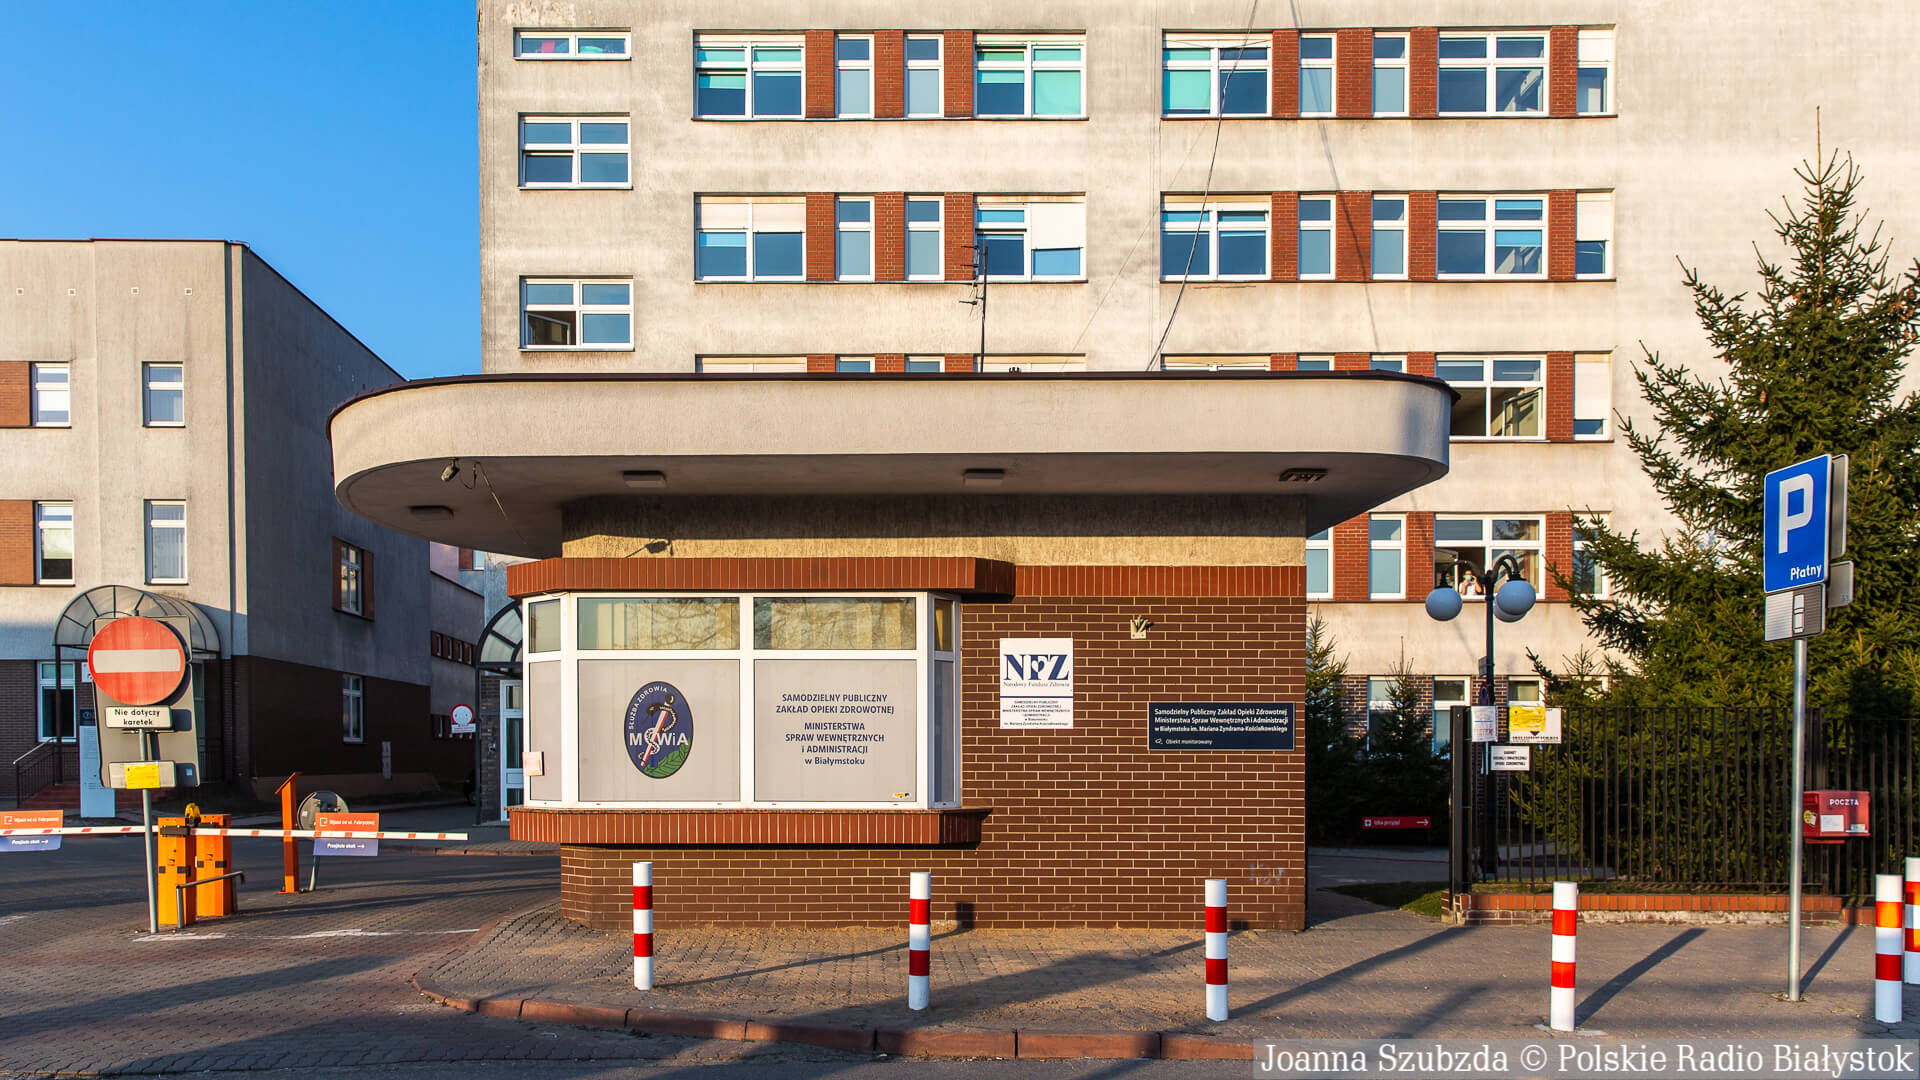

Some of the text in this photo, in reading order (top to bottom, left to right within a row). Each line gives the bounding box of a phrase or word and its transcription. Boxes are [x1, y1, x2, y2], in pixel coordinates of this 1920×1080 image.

[1778, 473, 1814, 554] P
[1790, 564, 1822, 581] Płatny
[1003, 654, 1069, 681] NFZ
[637, 685, 668, 704] ZDROWIA
[782, 694, 888, 702] SAMODZIELNY PUBLICZNY
[131, 709, 161, 718] dotyczy
[776, 705, 895, 714] ZAKŁAD OPIEKI ZDROWOTNEJ
[1154, 708, 1189, 716] Samodzielny
[1190, 708, 1217, 716] Publiczny
[1237, 708, 1255, 716] Opieki
[1256, 708, 1288, 716] Zdrowotnej
[123, 718, 153, 726] karetek
[1253, 717, 1289, 725] Administracji
[804, 722, 865, 730] MINISTERSTWA
[785, 734, 885, 743] SPRAW WEWNĘTRZNYCH
[806, 745, 868, 754] ADMINISTRACJI
[814, 757, 865, 766] Białymstoku
